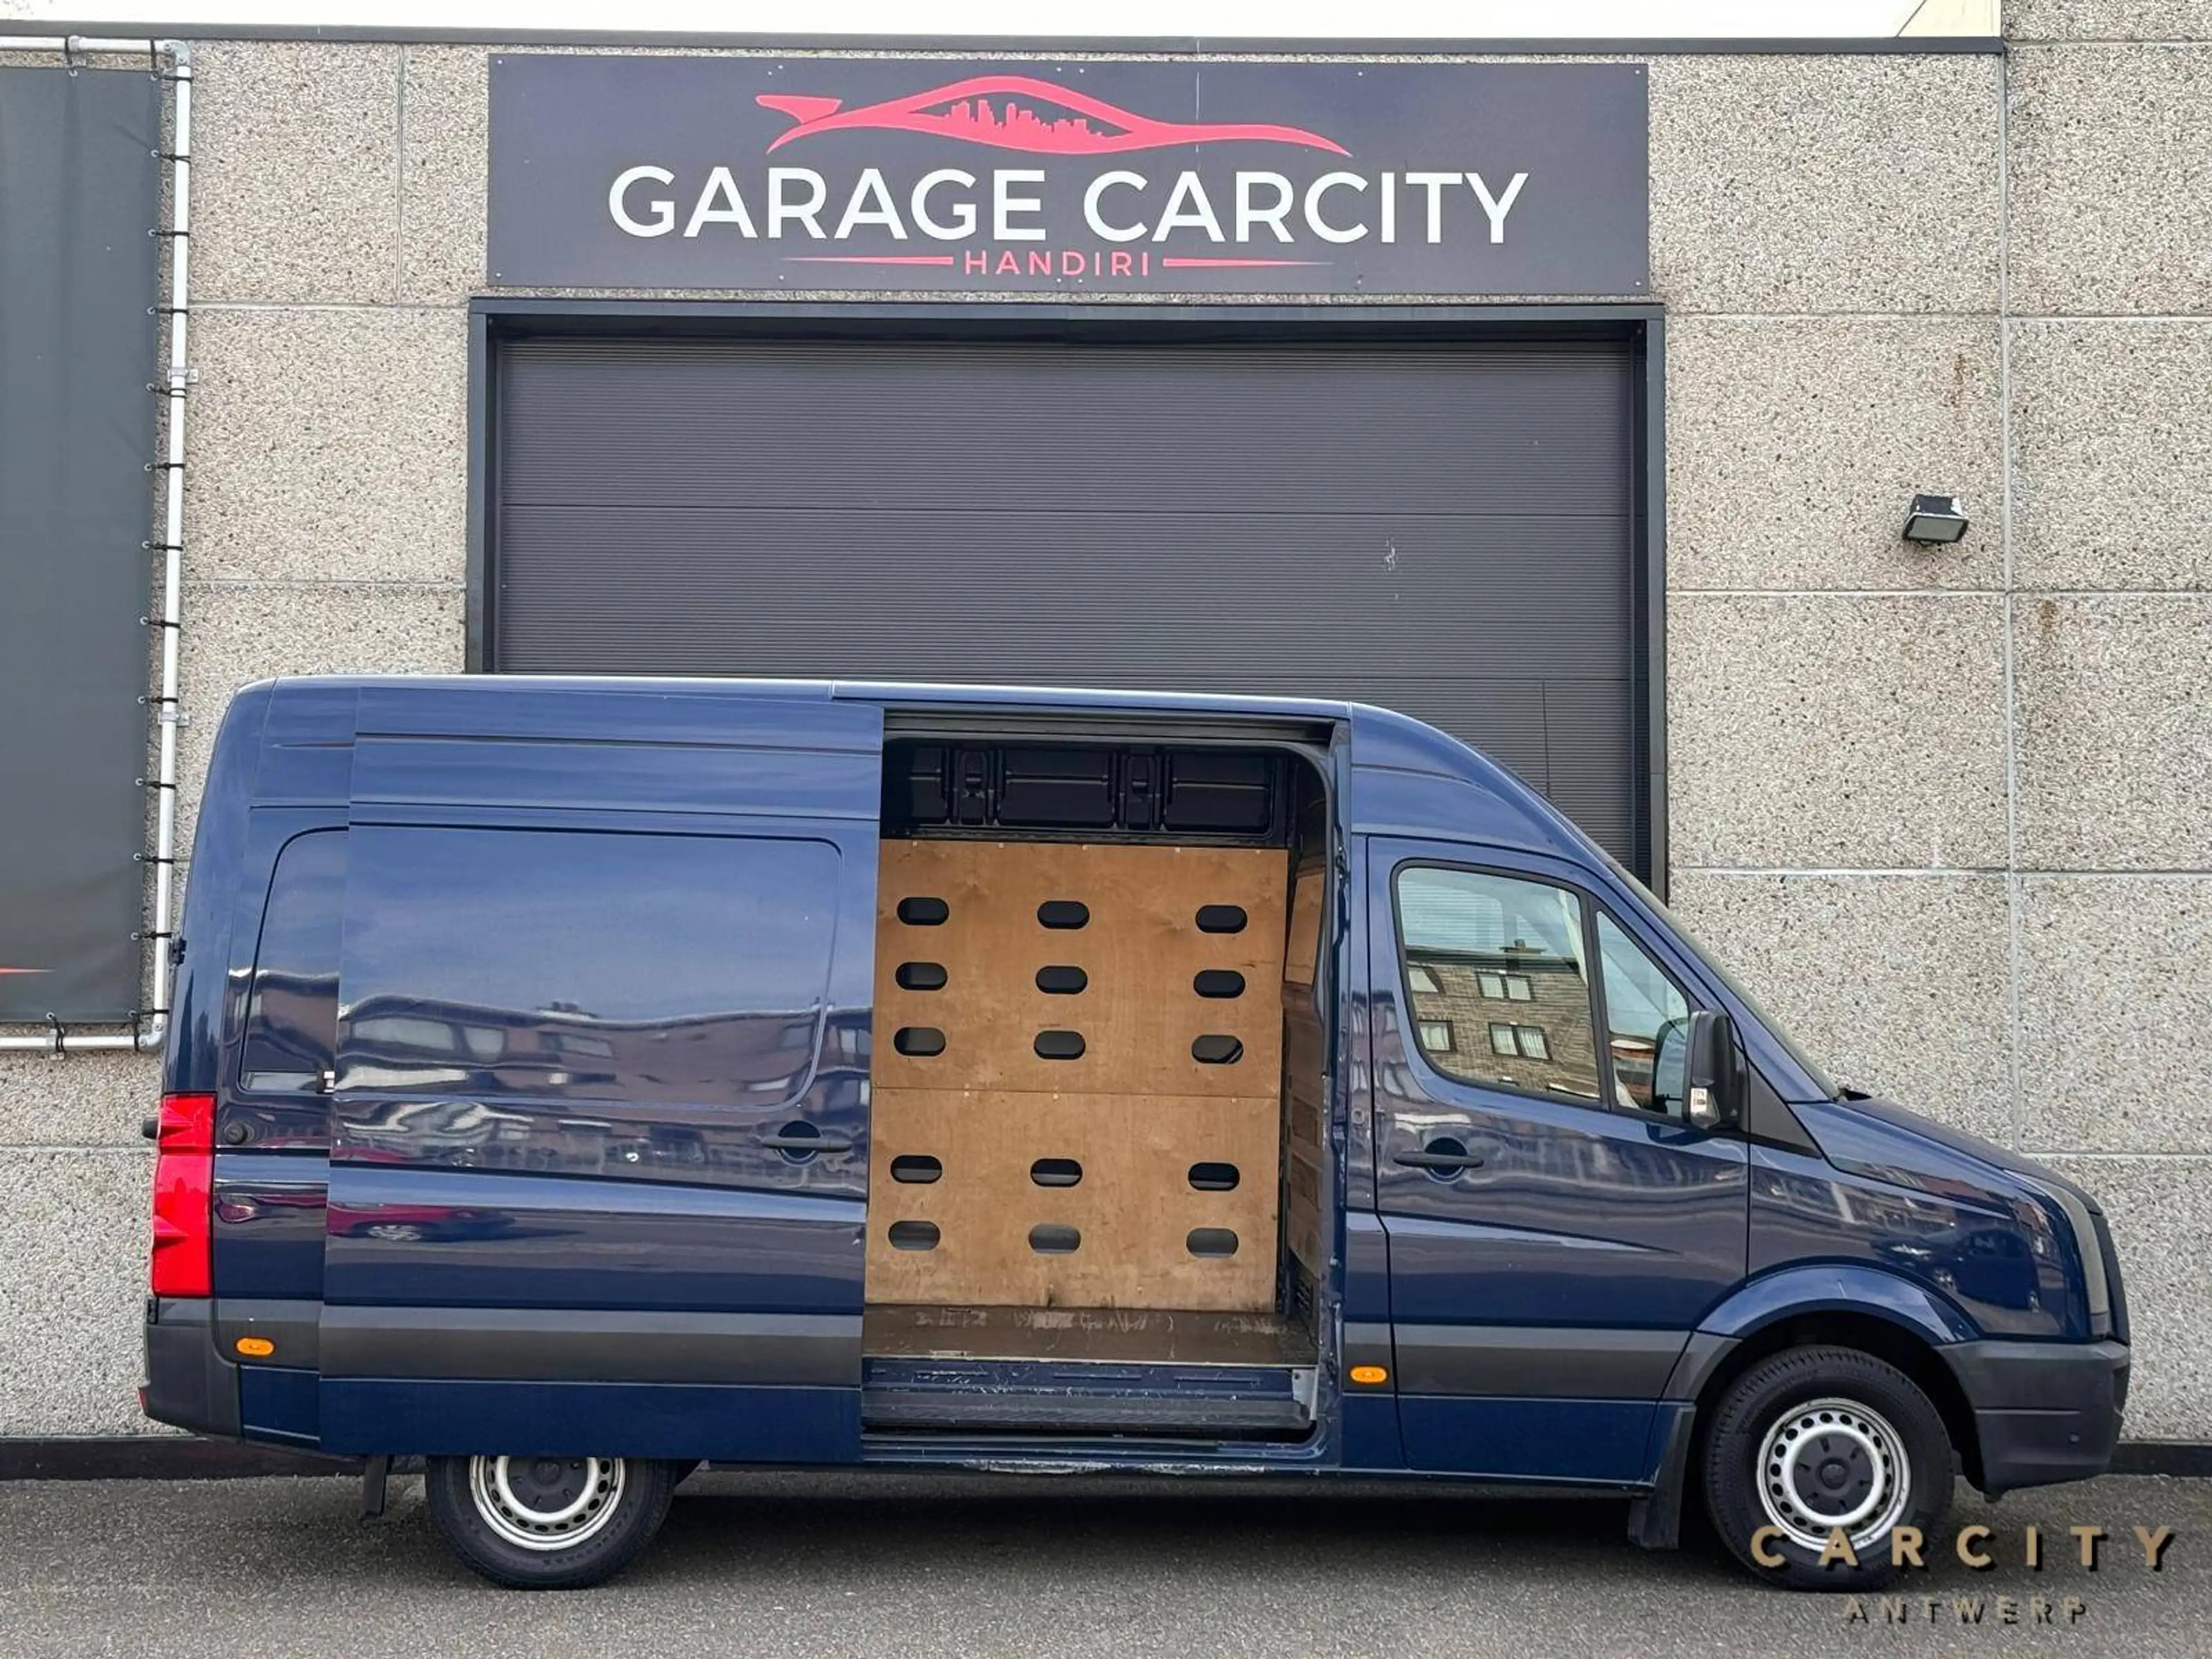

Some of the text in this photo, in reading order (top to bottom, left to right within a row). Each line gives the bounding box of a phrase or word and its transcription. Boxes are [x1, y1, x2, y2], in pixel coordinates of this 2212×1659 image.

[608, 165, 1529, 244] GARAGE CARCITY
[964, 250, 1150, 276] HANDIRI
